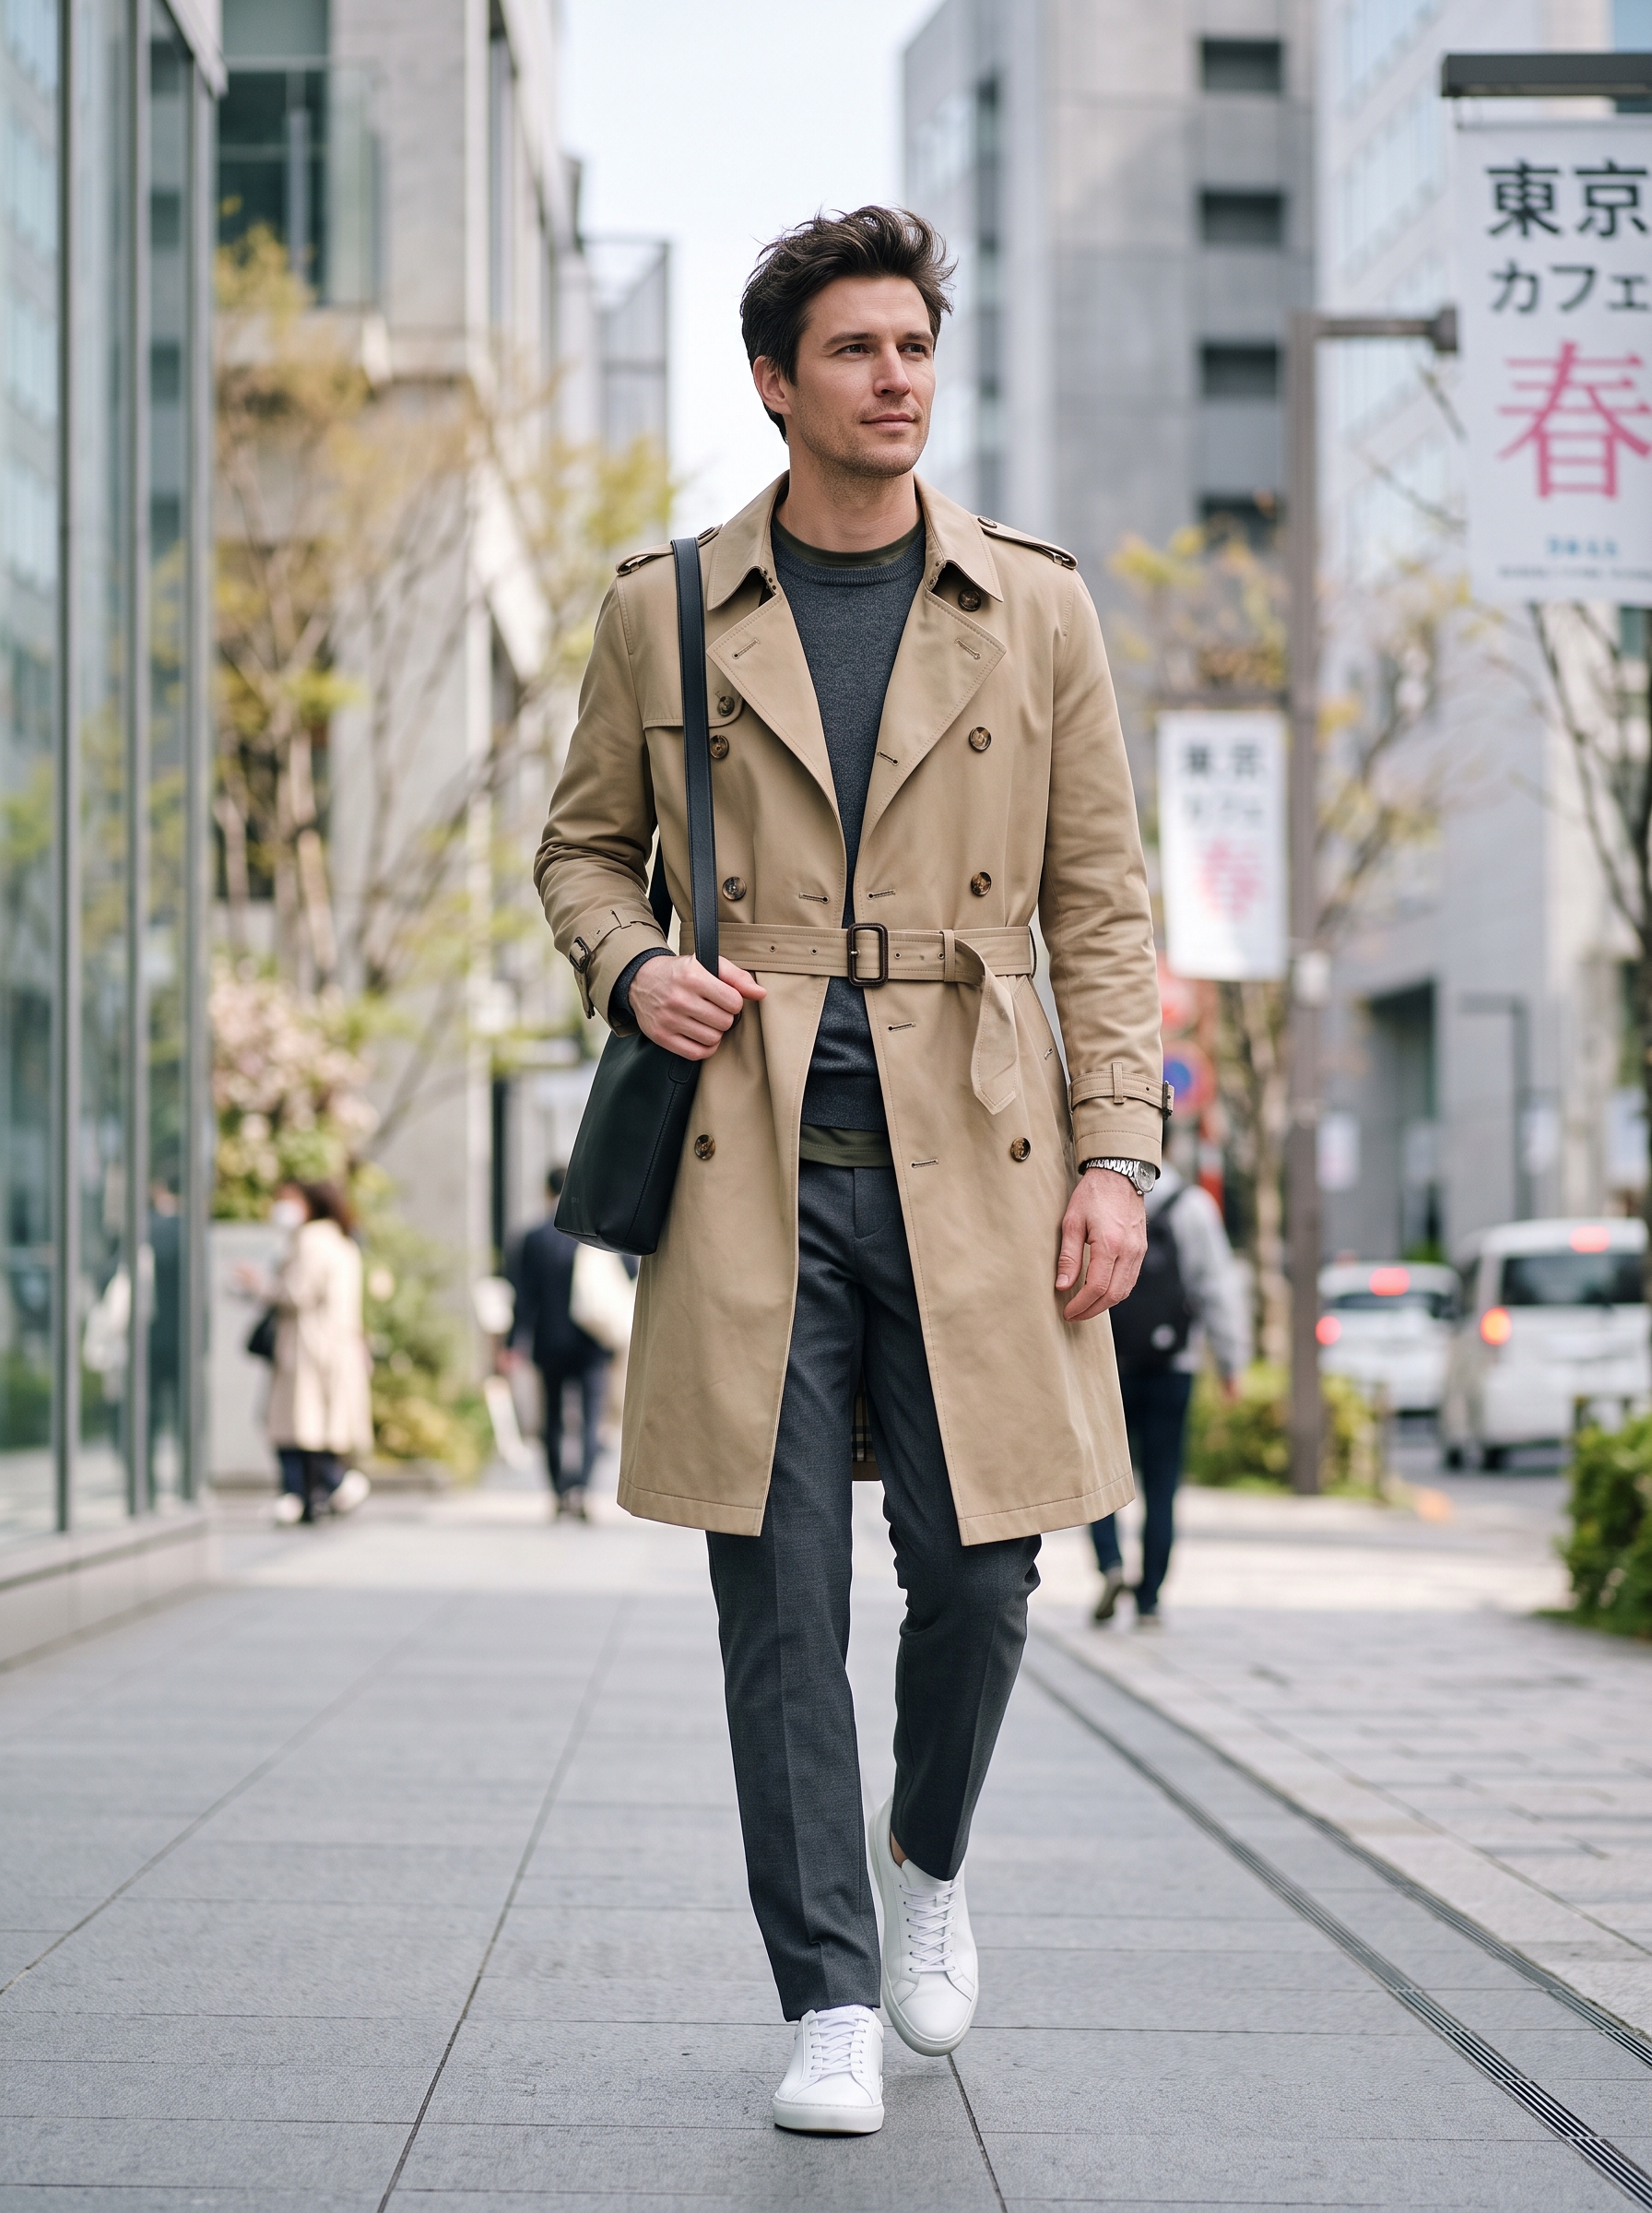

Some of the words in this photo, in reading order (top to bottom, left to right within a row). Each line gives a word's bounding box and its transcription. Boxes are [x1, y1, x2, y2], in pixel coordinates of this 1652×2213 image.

[1487, 160, 1649, 238] 東京
[1491, 260, 1650, 314] カフェ
[1498, 340, 1652, 500] 春
